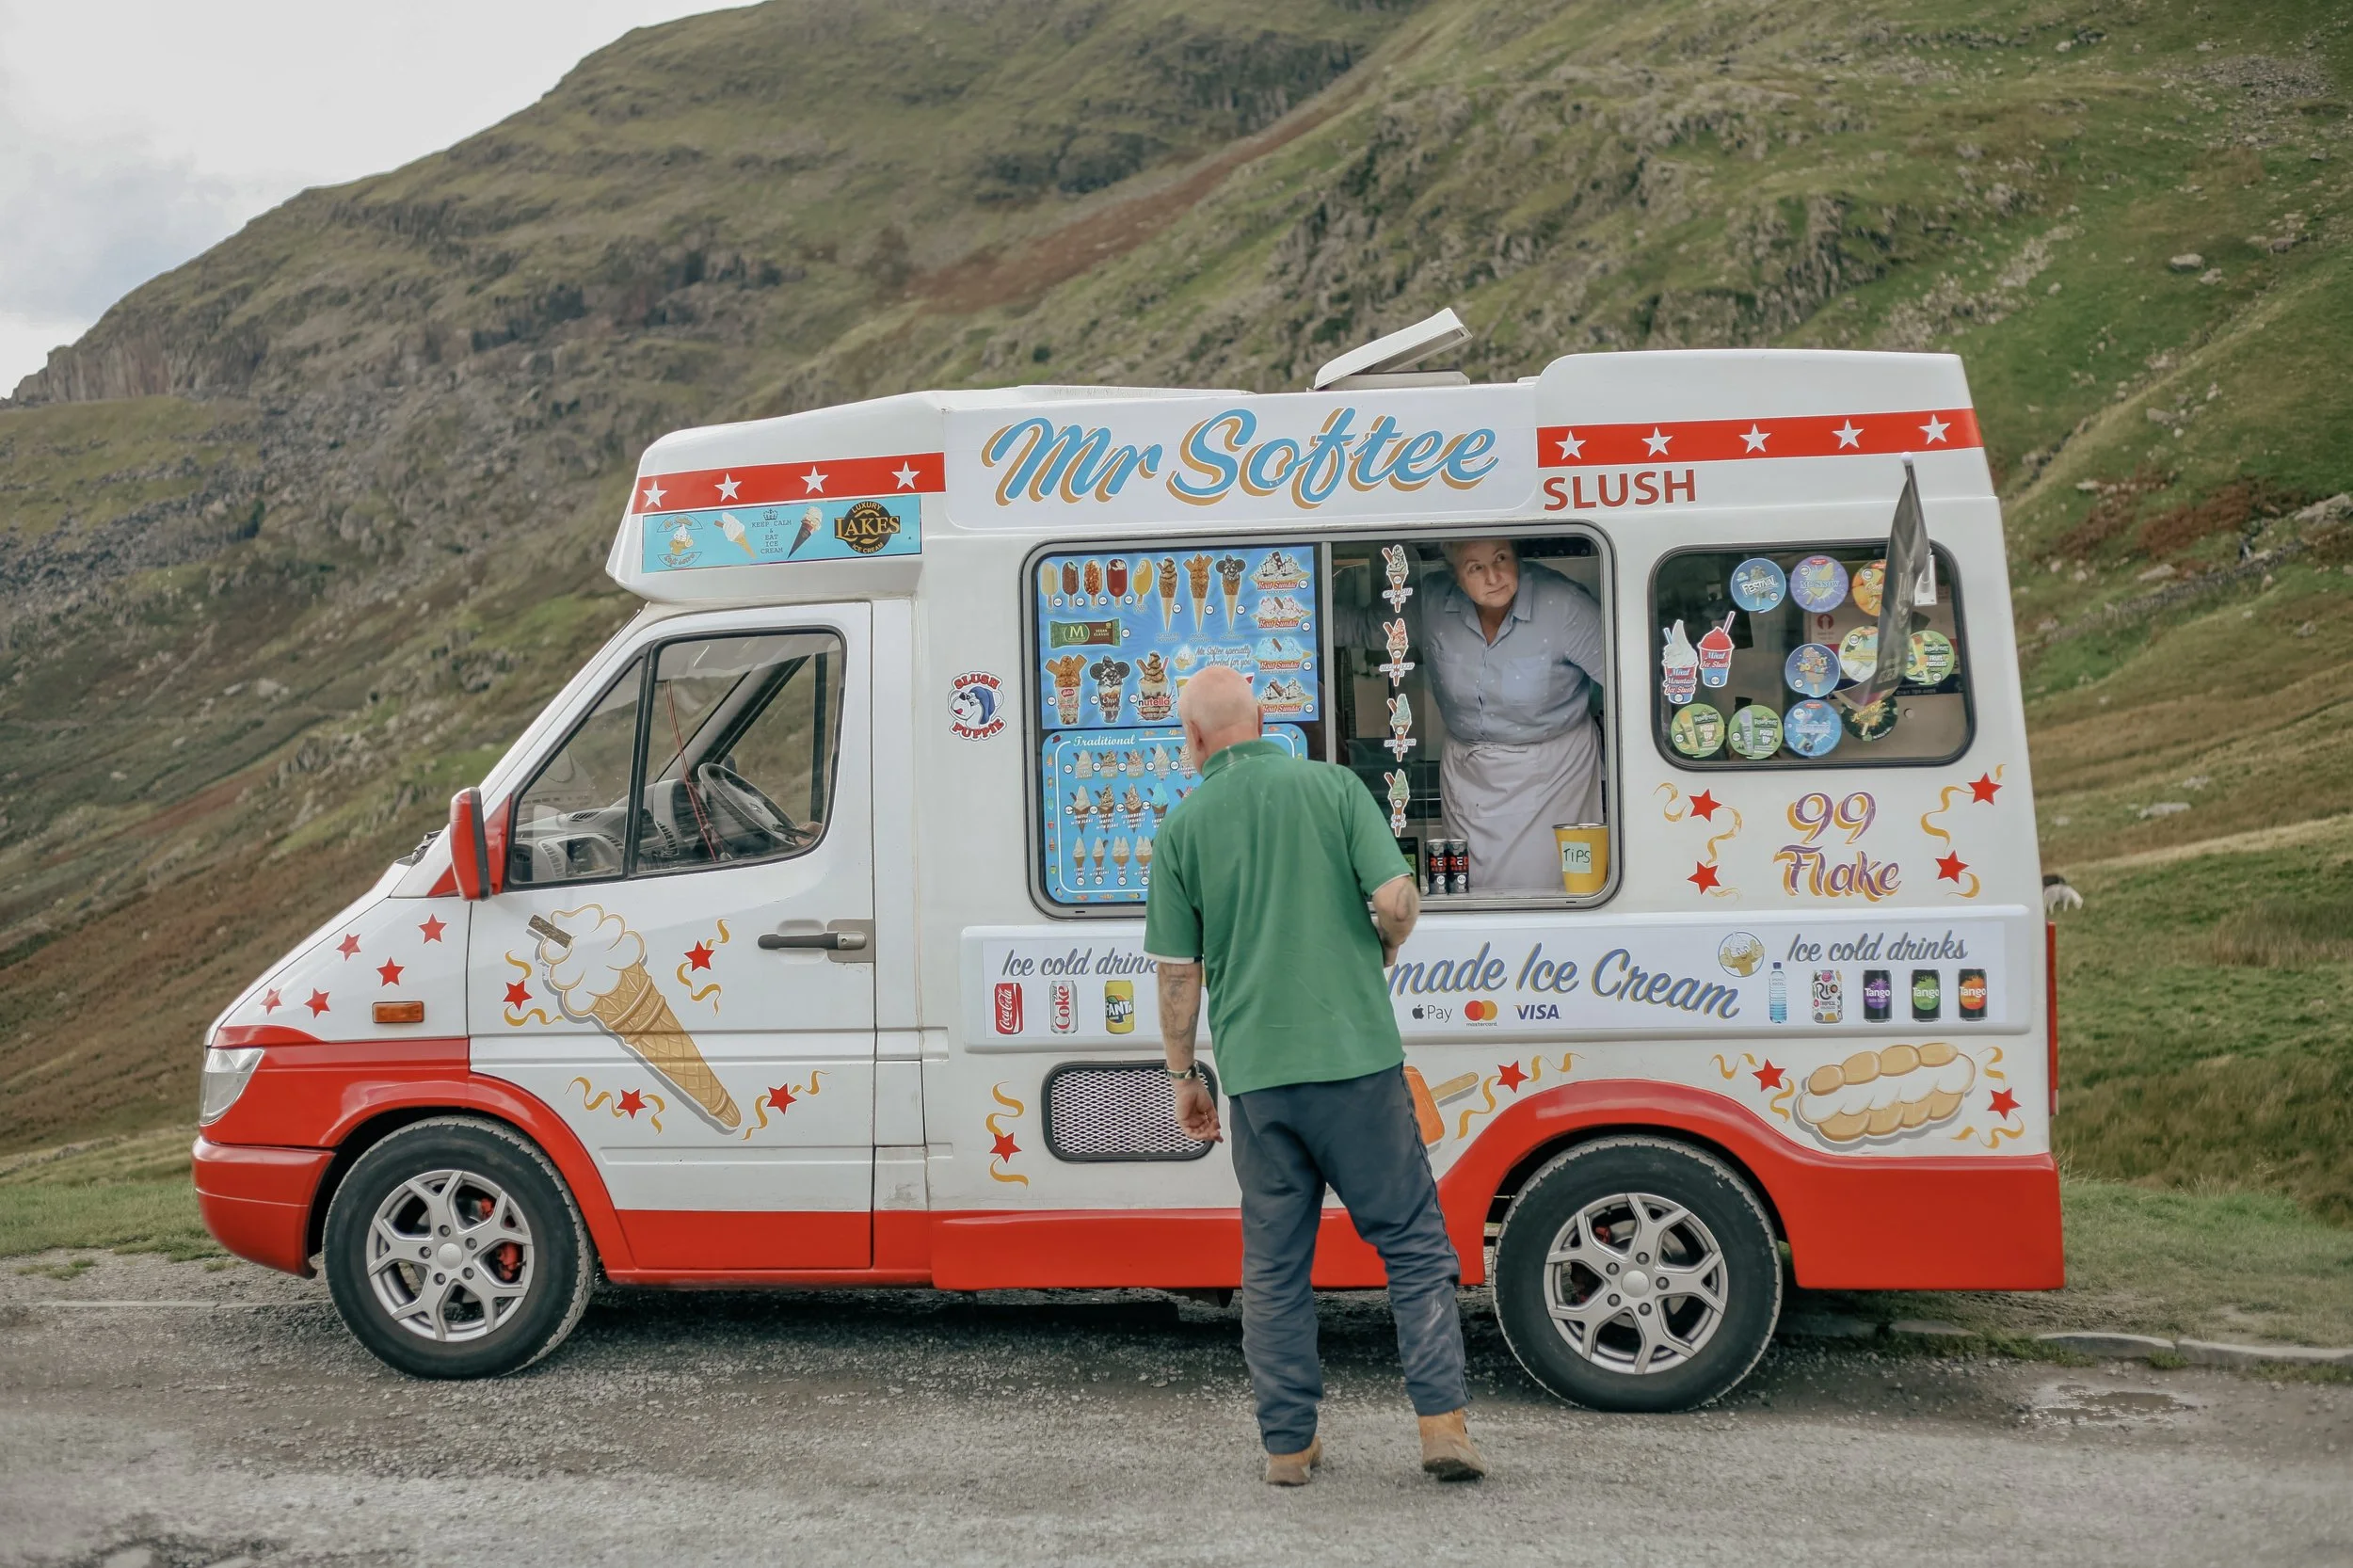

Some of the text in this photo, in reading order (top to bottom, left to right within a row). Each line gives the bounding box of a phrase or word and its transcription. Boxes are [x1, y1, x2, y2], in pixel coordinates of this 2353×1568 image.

[981, 407, 1500, 509] Mr Softee
[1543, 469, 1696, 511] SLUSH
[852, 502, 882, 514] LUXURY
[836, 516, 901, 542] LAKES
[852, 542, 885, 554] ICE CREAM
[1741, 576, 1778, 596] FESTIVAL
[953, 673, 1000, 690] SLUSH
[1139, 696, 1170, 706] nutella
[952, 718, 1005, 739] PUPPIE
[1074, 734, 1135, 746] Traditional
[1786, 791, 1877, 845] 99
[1772, 844, 1902, 903] Flake
[1787, 930, 1968, 962] Ice cold drinks
[1001, 947, 1158, 976] Ice cold drink
[1515, 941, 1579, 994] Ice
[1591, 948, 1740, 1020] Cream
[1816, 983, 1839, 1000] RIO
[1865, 987, 1891, 999] Tango
[1913, 986, 1939, 999] Tango
[1960, 986, 1987, 999] Tango
[1055, 985, 1071, 1030] Coke
[1105, 1000, 1133, 1016] FANTA
[1427, 1004, 1452, 1023] Pay
[1513, 1004, 1561, 1020] VISA
